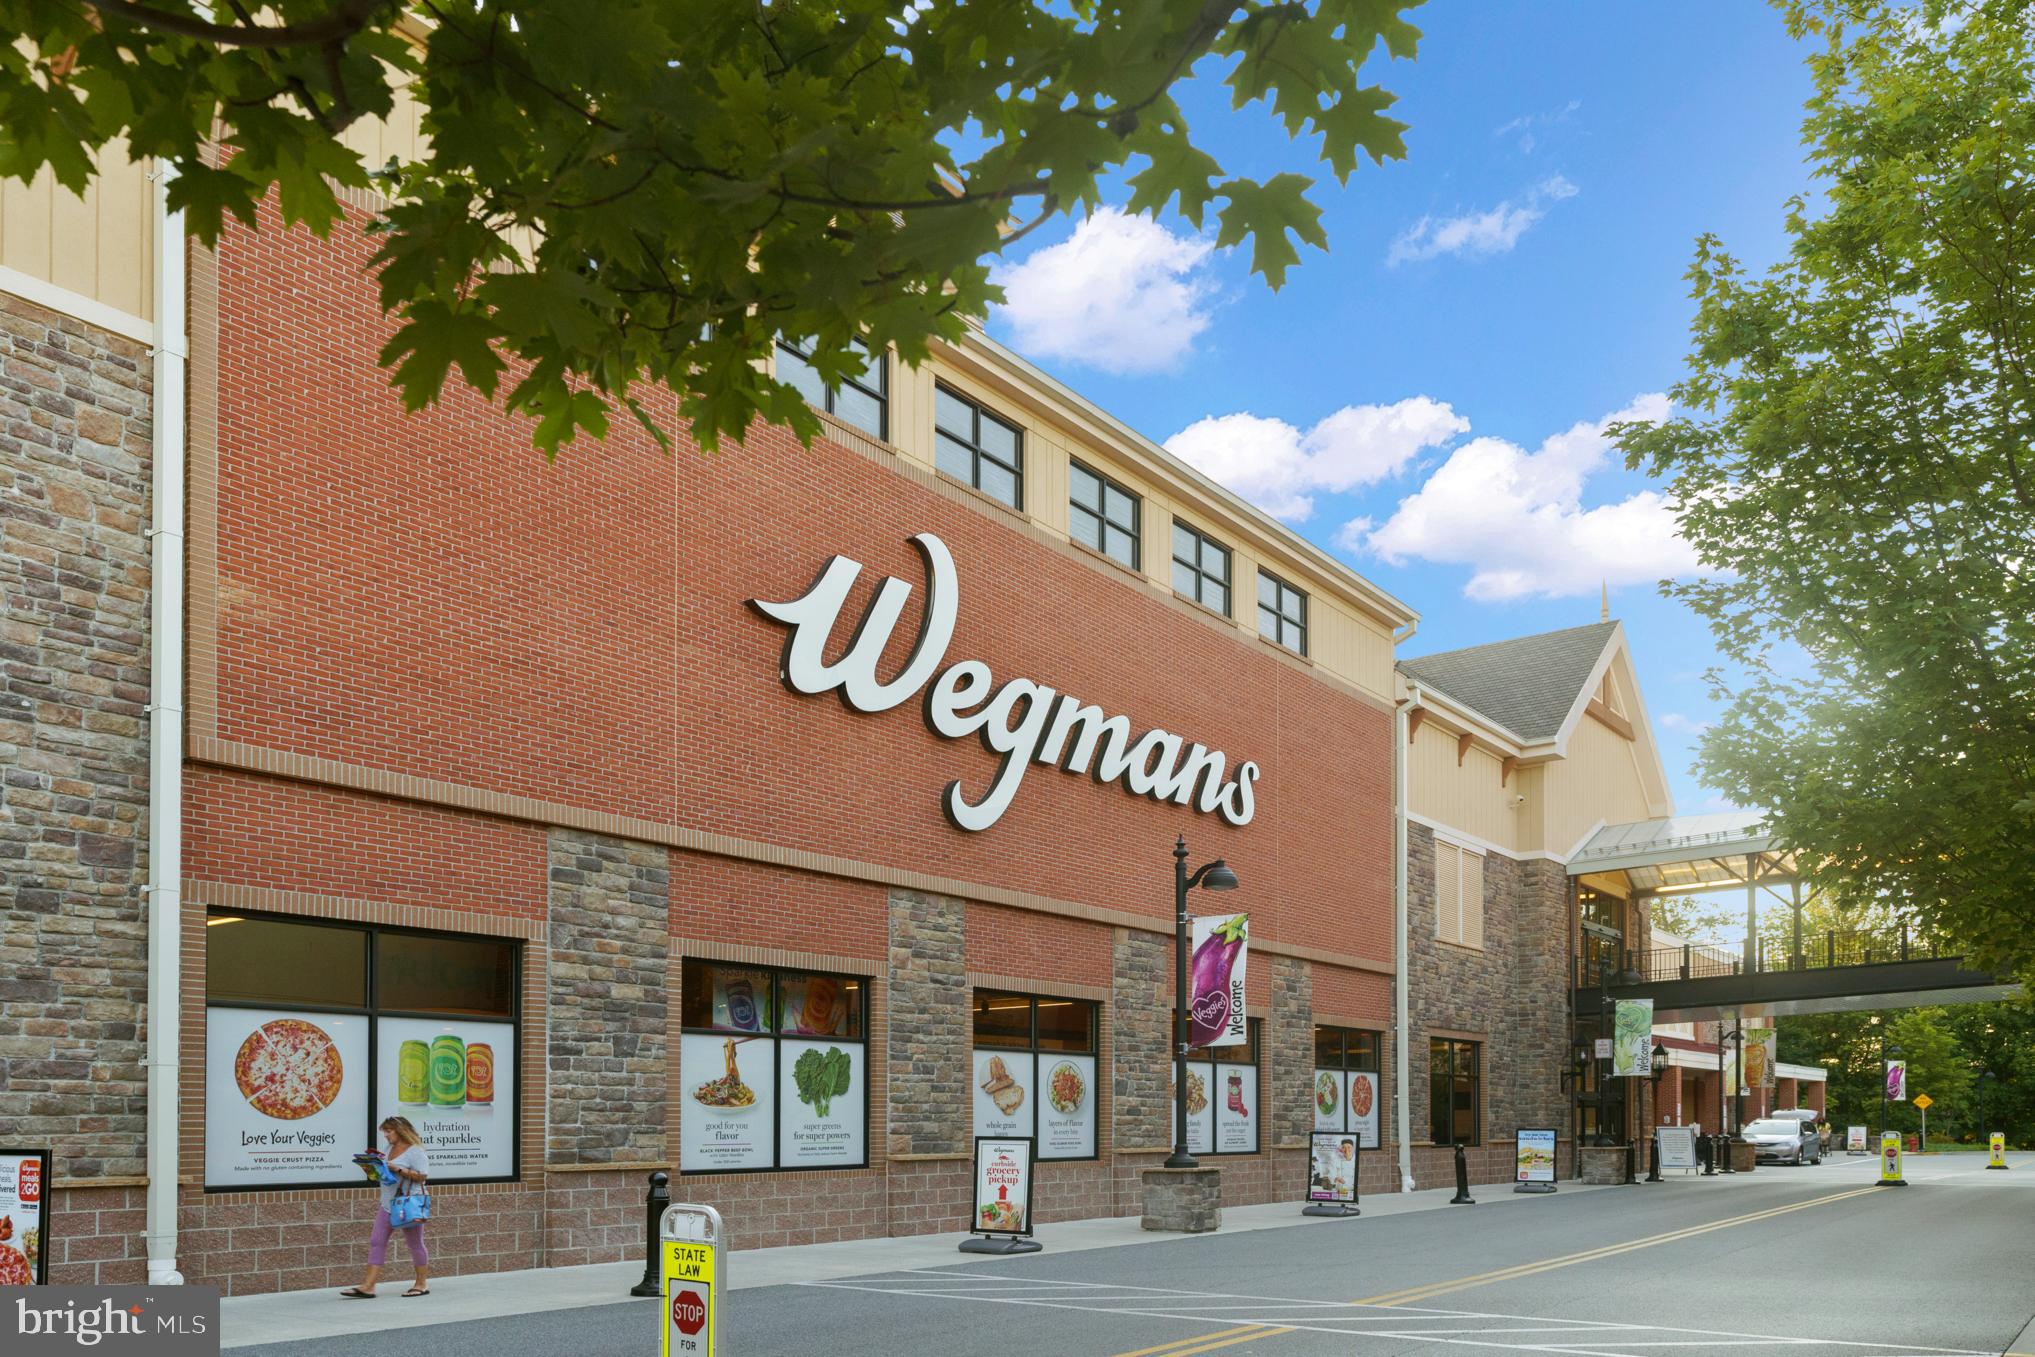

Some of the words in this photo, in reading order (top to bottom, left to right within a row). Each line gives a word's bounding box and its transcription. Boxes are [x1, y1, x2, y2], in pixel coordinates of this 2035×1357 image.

[752, 532, 1260, 831] Wegmans
[1193, 996, 1226, 1020] Veggies
[1226, 980, 1243, 1036] Welcome
[1636, 1038, 1650, 1072] Welcome
[423, 1121, 470, 1134] hydration
[705, 1122, 723, 1131] good
[724, 1121, 735, 1130] for
[735, 1123, 748, 1132] you
[804, 1123, 820, 1131] super
[822, 1123, 842, 1131] greens
[986, 1121, 1001, 1129] whole
[1002, 1121, 1017, 1130] grain
[242, 1130, 267, 1146] Love
[270, 1129, 294, 1145] Your
[296, 1130, 336, 1147] Veggies
[436, 1133, 482, 1147] sparkles
[715, 1131, 739, 1140] flavor
[794, 1131, 804, 1139] for
[806, 1133, 826, 1141] super
[826, 1132, 851, 1141] powers
[288, 1164, 314, 1172] containing
[315, 1163, 343, 1171] ingredients
[986, 1166, 1021, 1176] grocery
[22, 1172, 39, 1182] meals
[988, 1174, 1019, 1186] pickup
[21, 1183, 39, 1195] 2GO
[673, 1248, 706, 1263] STATE
[678, 1264, 701, 1277] LAW
[674, 1303, 704, 1322] STOP
[680, 1339, 697, 1351] FOR
